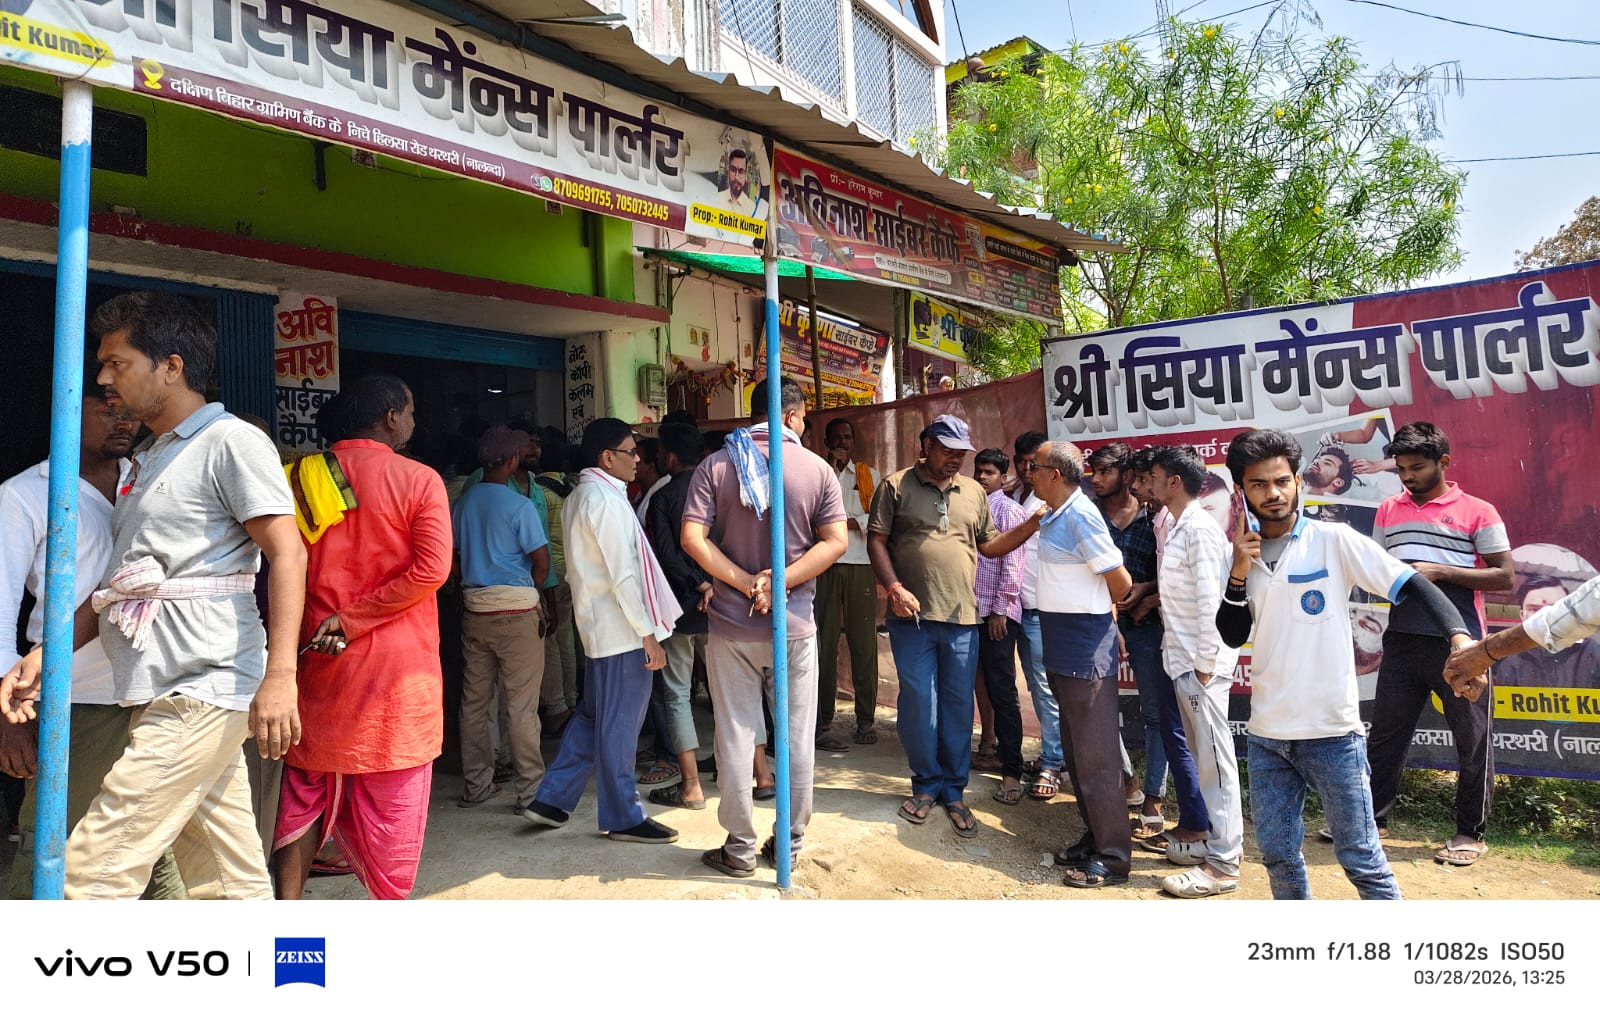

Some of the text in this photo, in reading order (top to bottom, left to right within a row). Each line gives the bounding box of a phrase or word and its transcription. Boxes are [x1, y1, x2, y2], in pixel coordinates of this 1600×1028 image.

[28, 25, 104, 60] Kumar
[169, 77, 213, 101] दक्षिण
[328, 116, 342, 133] के
[372, 128, 409, 153] हिलसा
[409, 138, 428, 157] रोड
[562, 92, 684, 177] पार्लर
[552, 176, 670, 222] 8709691755, 7050732445
[692, 206, 764, 235] Prop:- Rohit Kumar
[779, 174, 869, 242] अविनाश
[276, 297, 335, 341] अवि
[275, 340, 335, 377] नाश
[1053, 282, 1592, 419] श्री सिया मेंन्स पार्लर
[1511, 693, 1570, 714] Rohit
